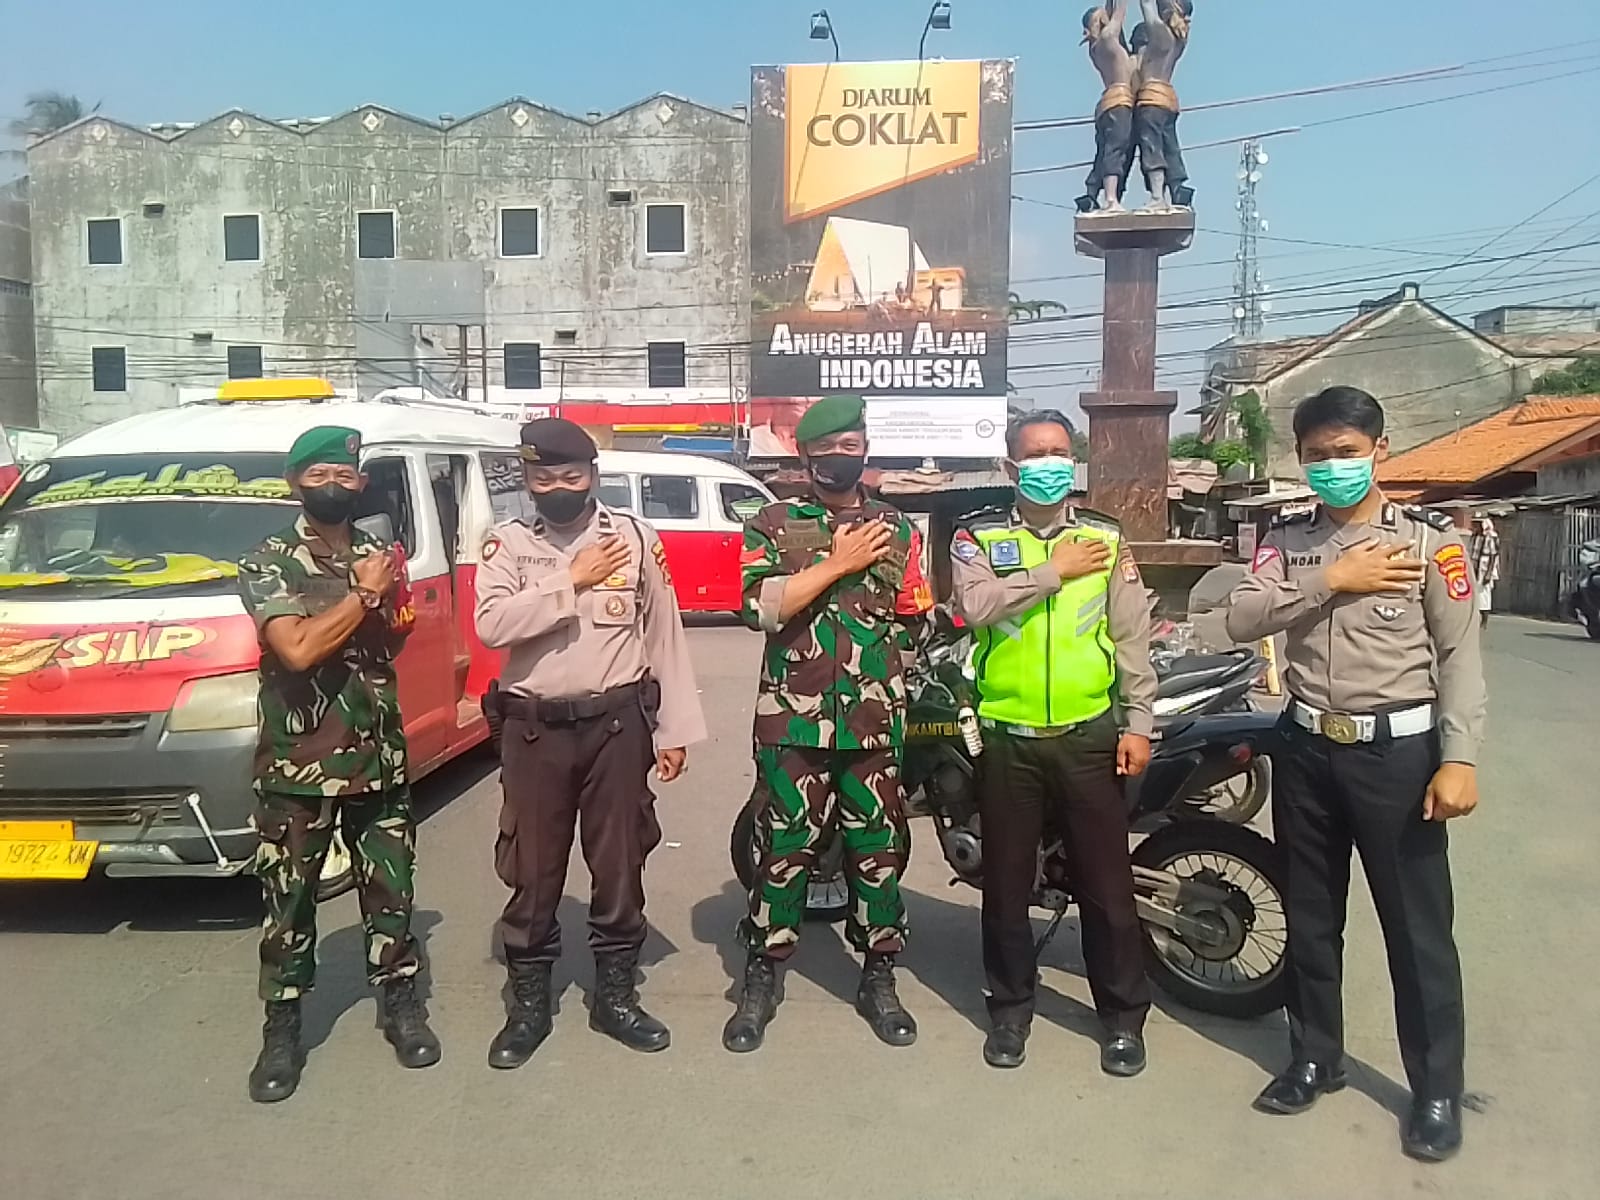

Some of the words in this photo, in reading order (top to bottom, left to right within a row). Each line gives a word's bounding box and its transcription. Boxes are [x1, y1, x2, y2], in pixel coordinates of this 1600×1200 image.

[842, 87, 933, 109] DJARUM
[806, 111, 969, 147] COKLAT
[768, 321, 904, 357] ANUGERAH
[910, 320, 988, 356] ALAM
[818, 358, 985, 390] INDONESIA
